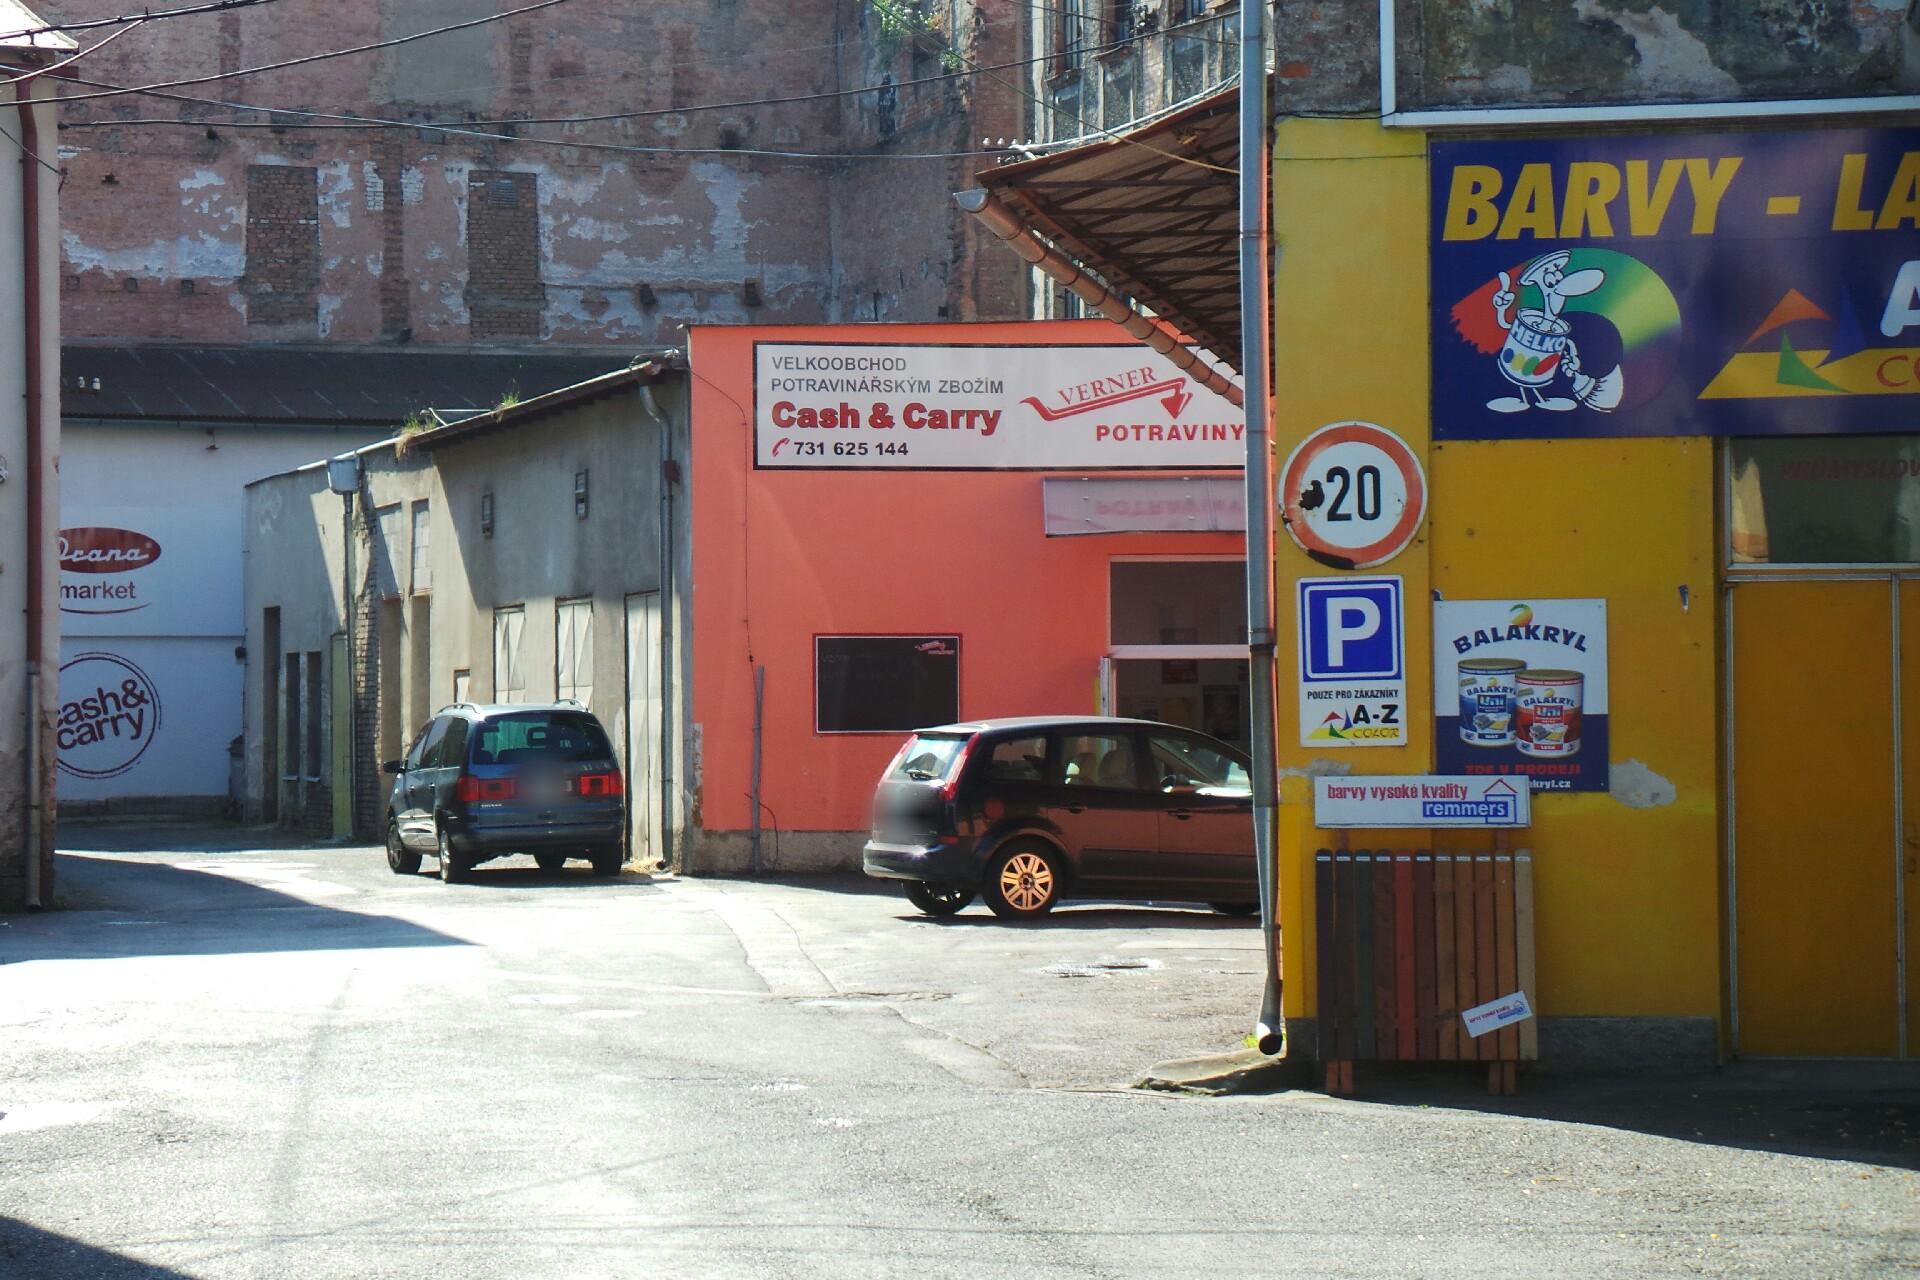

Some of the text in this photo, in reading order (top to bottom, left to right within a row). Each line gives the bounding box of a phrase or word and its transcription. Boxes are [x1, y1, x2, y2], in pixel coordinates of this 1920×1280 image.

[1442, 156, 1744, 242] BARVY
[1511, 318, 1567, 352] HELKO
[771, 356, 907, 371] VELKOOBCHOD
[1876, 354, 1920, 387] C
[770, 376, 1004, 394] POTRAVINÁŘSKÝM ZBOŽÍM
[1058, 366, 1158, 405] VERNER
[771, 401, 1002, 436] Cash & Carry
[1096, 424, 1245, 441] POTRAVINY
[793, 442, 909, 456] 731 625 144
[1326, 465, 1381, 522] 20
[60, 580, 137, 599] market
[1326, 596, 1381, 667] P
[1453, 624, 1587, 654] BALAKRYL
[58, 679, 149, 728] ash&
[1307, 687, 1399, 700] POUZE PRO ZÁKAZNÍKY
[1352, 703, 1400, 725] A-Z
[57, 708, 143, 750] carry
[1352, 727, 1400, 739] COLOR
[1499, 764, 1509, 774] V
[1515, 763, 1581, 774] PRODEJI
[1327, 783, 1468, 801] barvy vysoké kvality
[1425, 801, 1506, 816] remmers
